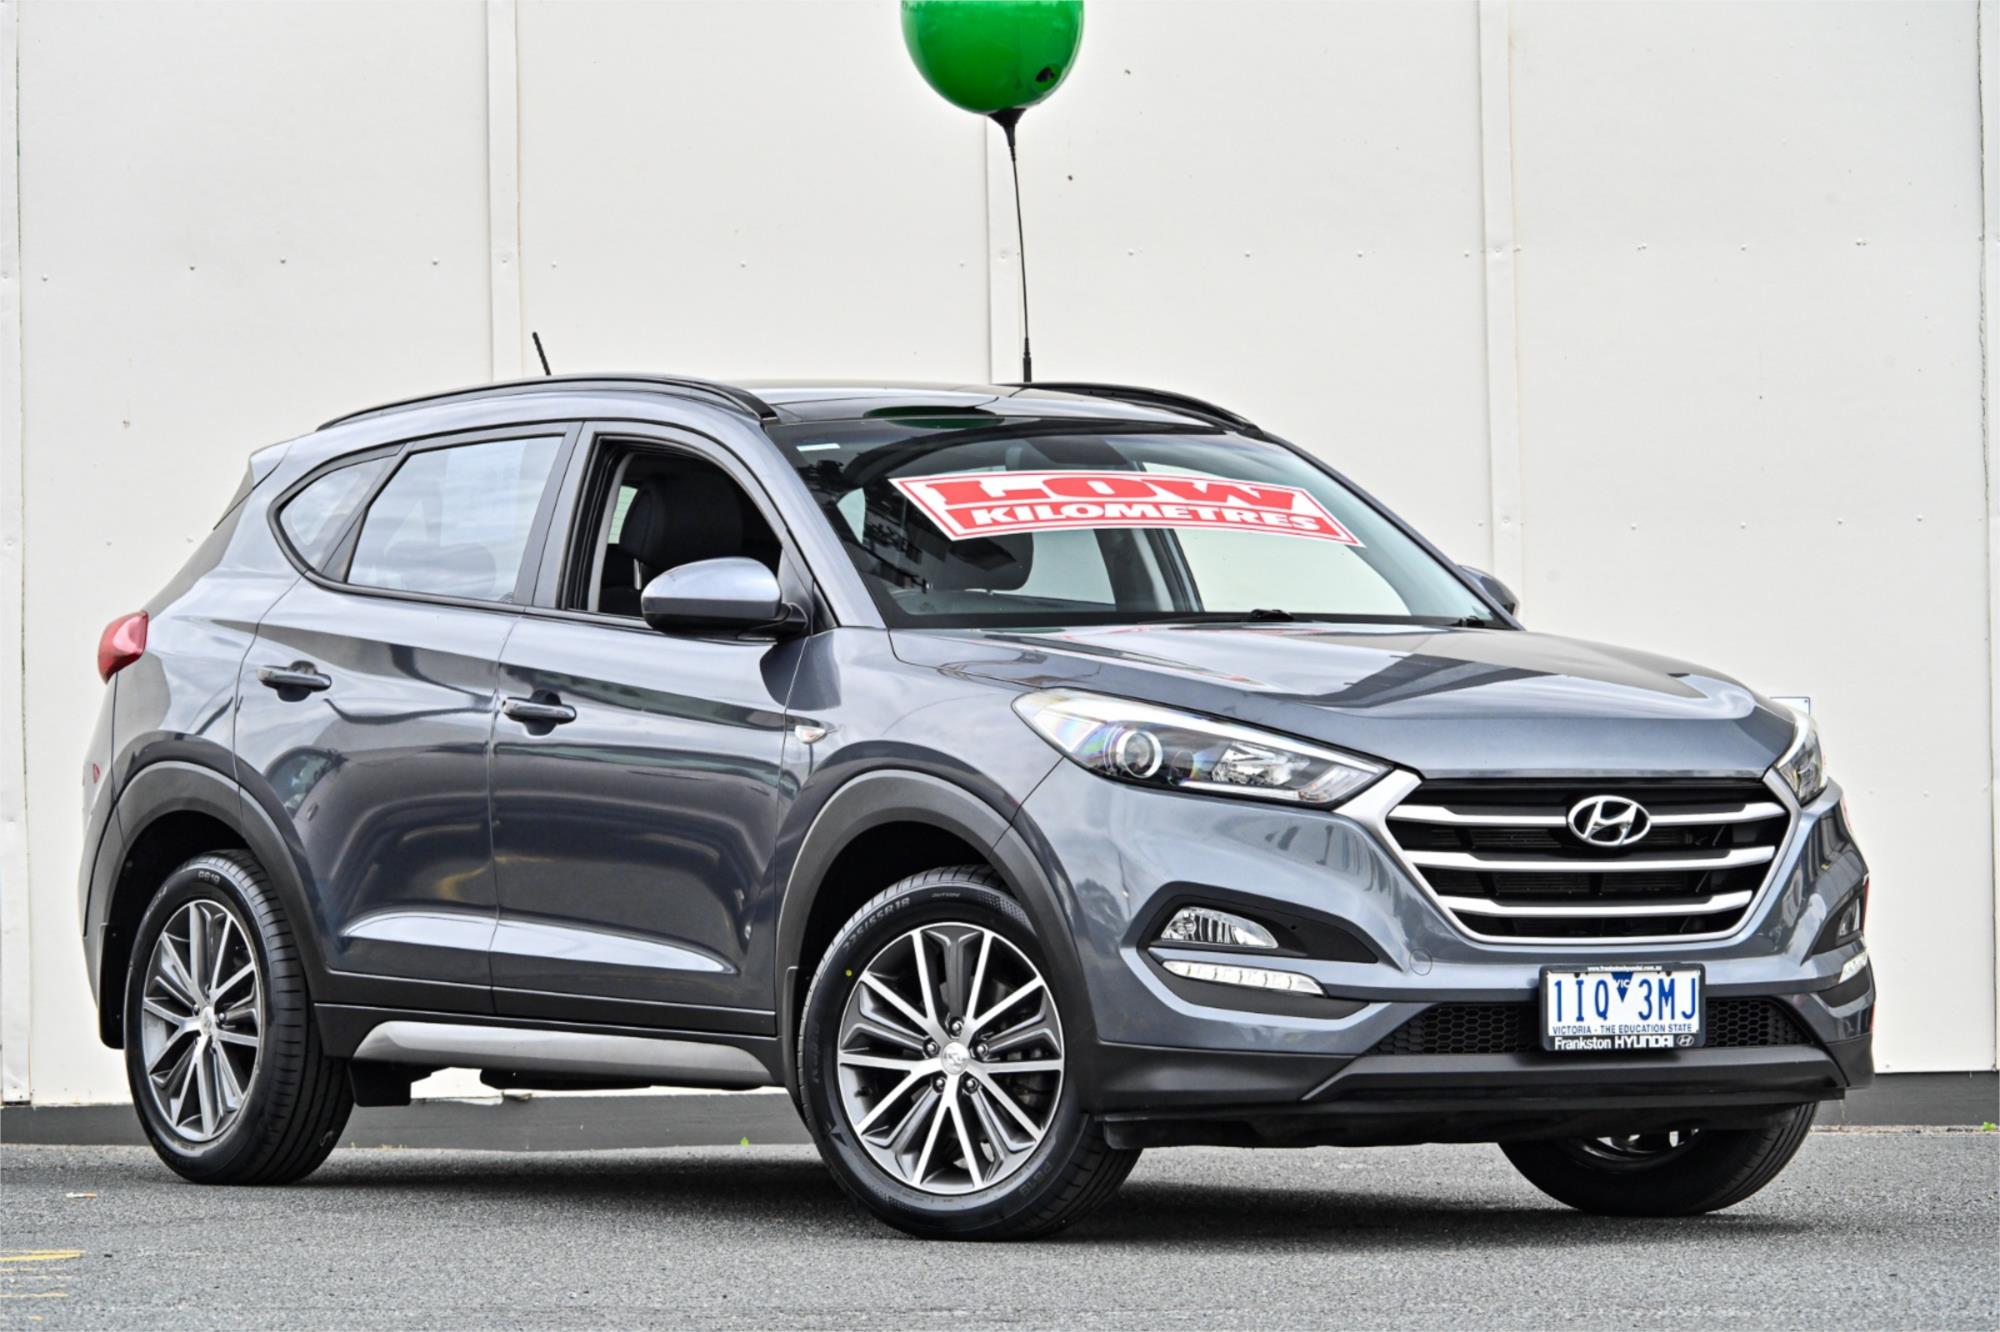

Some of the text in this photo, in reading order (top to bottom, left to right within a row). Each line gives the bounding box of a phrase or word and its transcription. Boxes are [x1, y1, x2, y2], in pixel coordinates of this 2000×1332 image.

[925, 476, 1296, 511] LOW
[970, 503, 1321, 531] KILOMETRES
[1638, 978, 1696, 1021] 3MJ
[1552, 1025, 1592, 1035] VICTORIA
[1600, 1024, 1616, 1034] THE
[1618, 1023, 1665, 1033] EDUCATION
[1668, 1023, 1692, 1033] STATE
[1555, 1035, 1675, 1050] Frankston HYUNDAI
